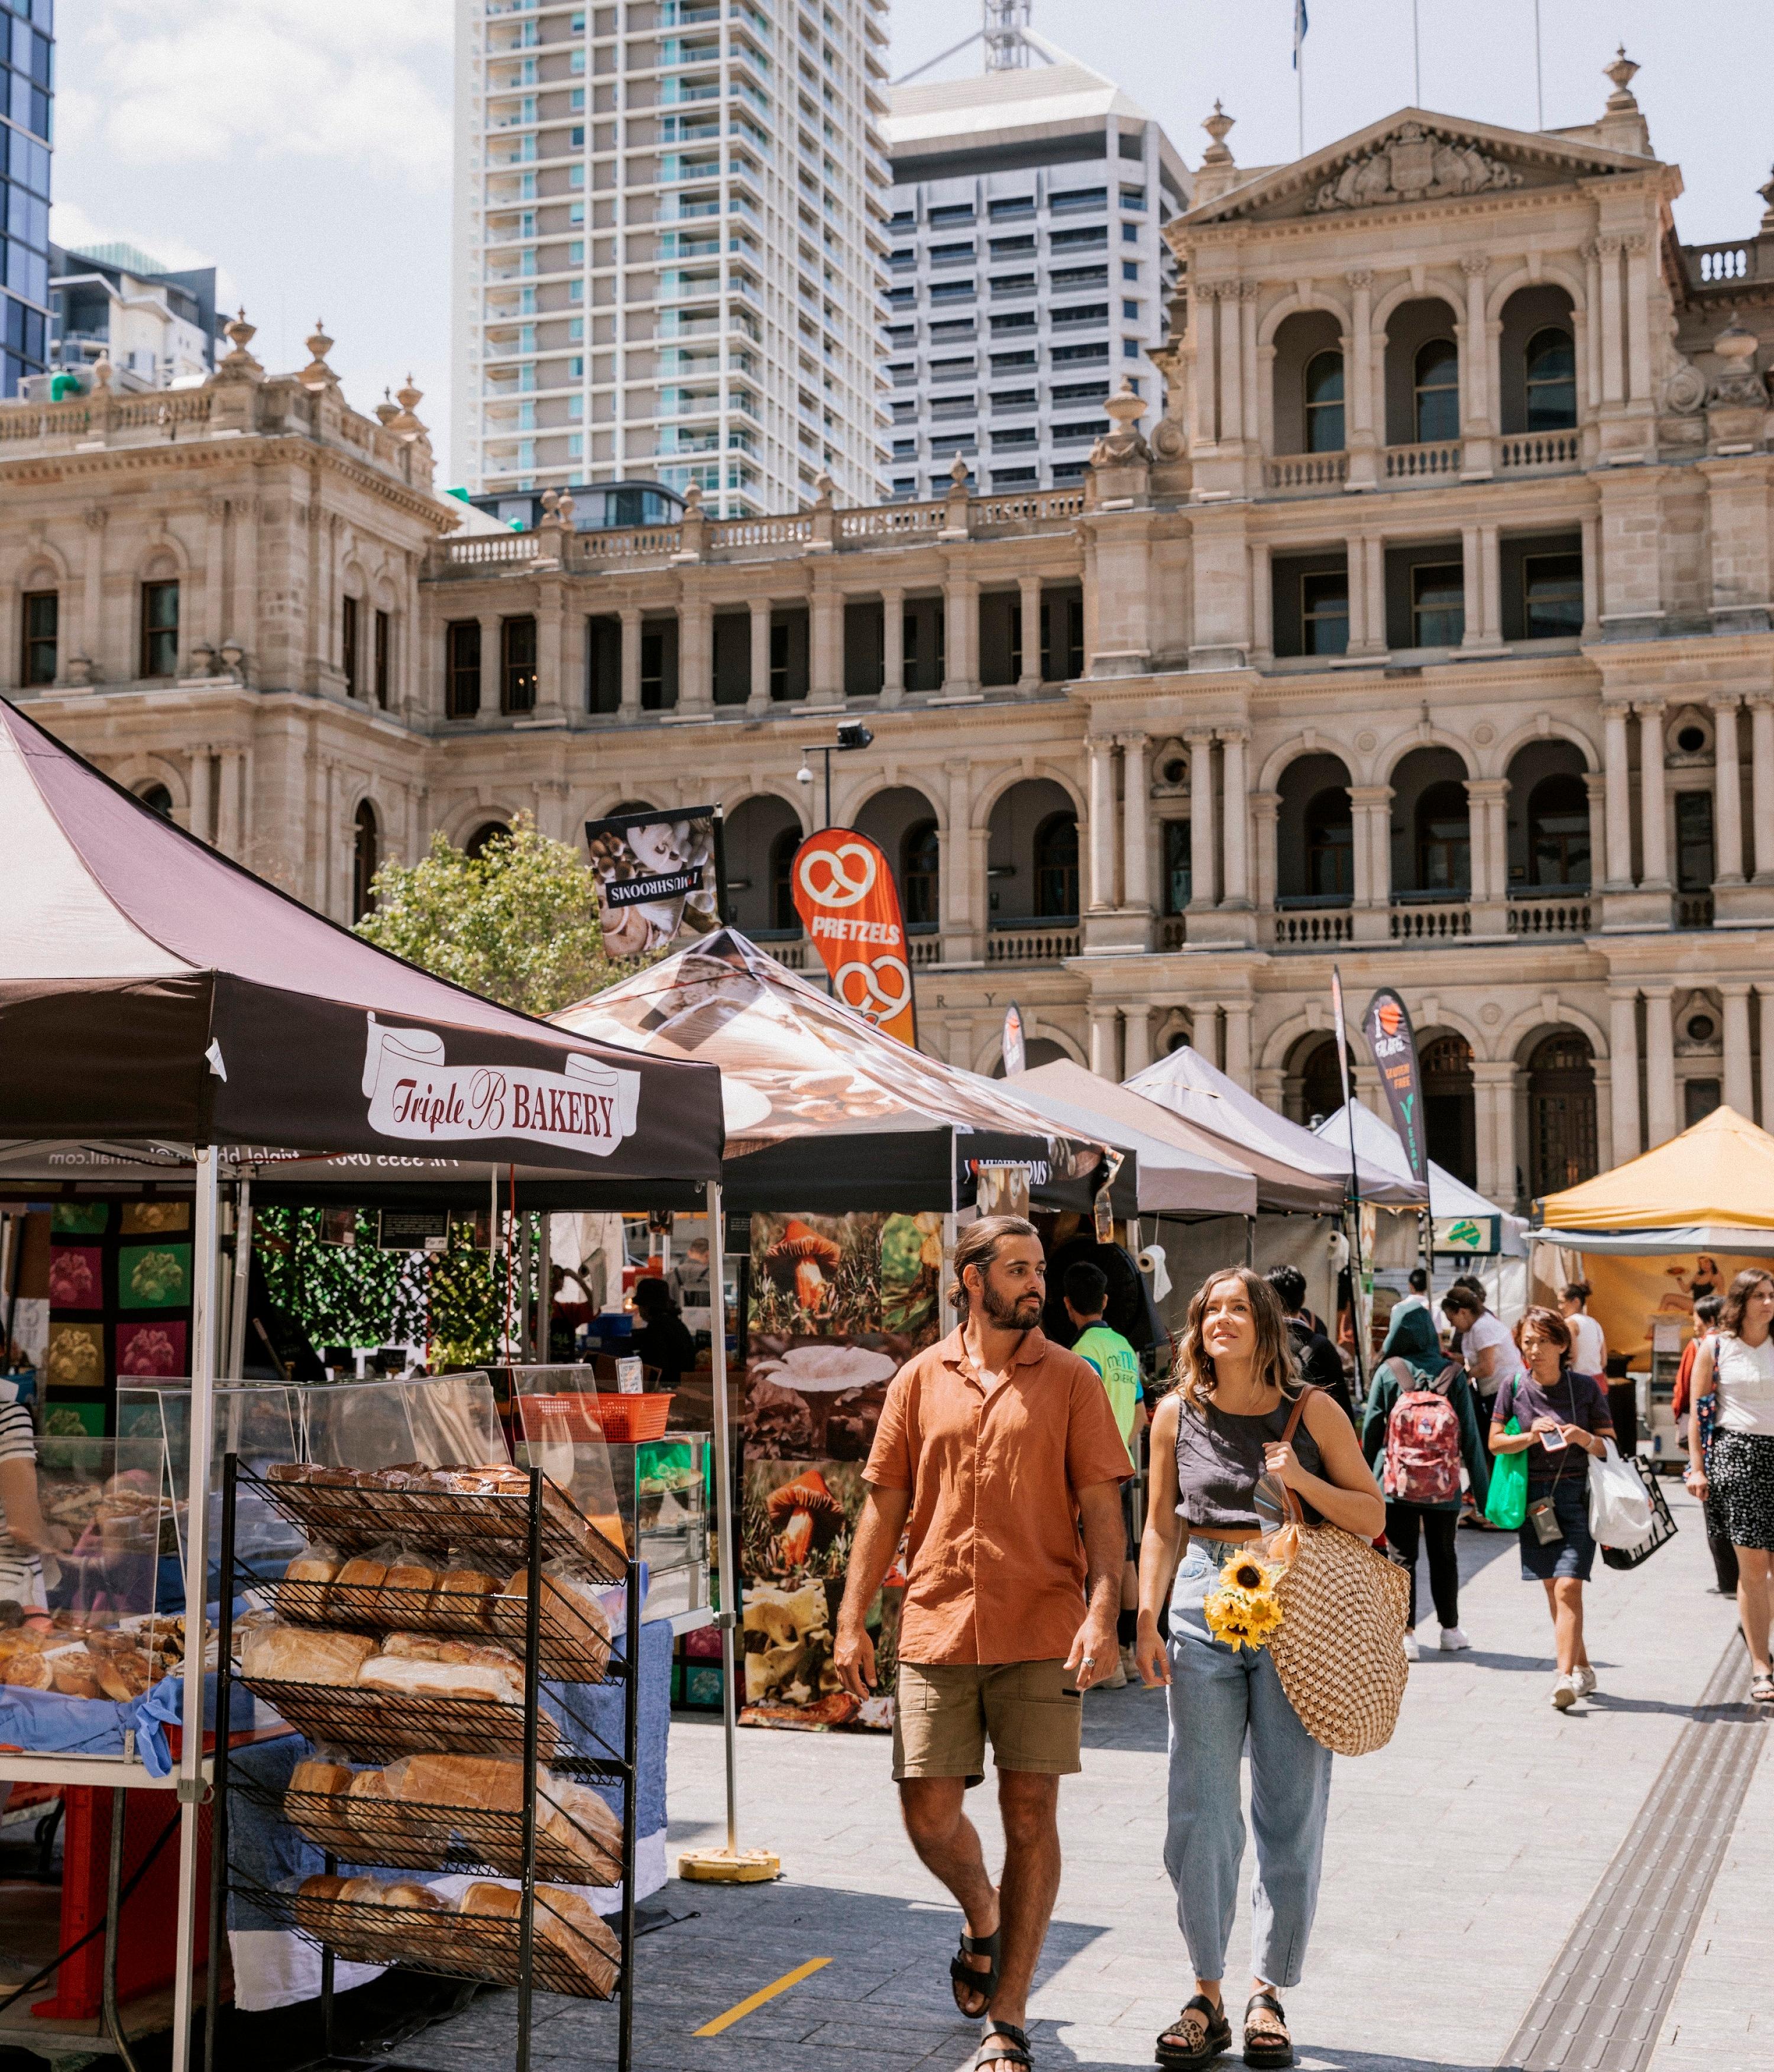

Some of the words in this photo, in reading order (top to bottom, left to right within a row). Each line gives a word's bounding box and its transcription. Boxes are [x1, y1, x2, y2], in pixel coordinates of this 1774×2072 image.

[610, 875, 689, 901] MUSHROOMS
[811, 915, 901, 946] PRETZELS
[393, 1078, 465, 1134] Triple
[467, 1069, 507, 1131] B
[512, 1083, 615, 1138] BAKERY
